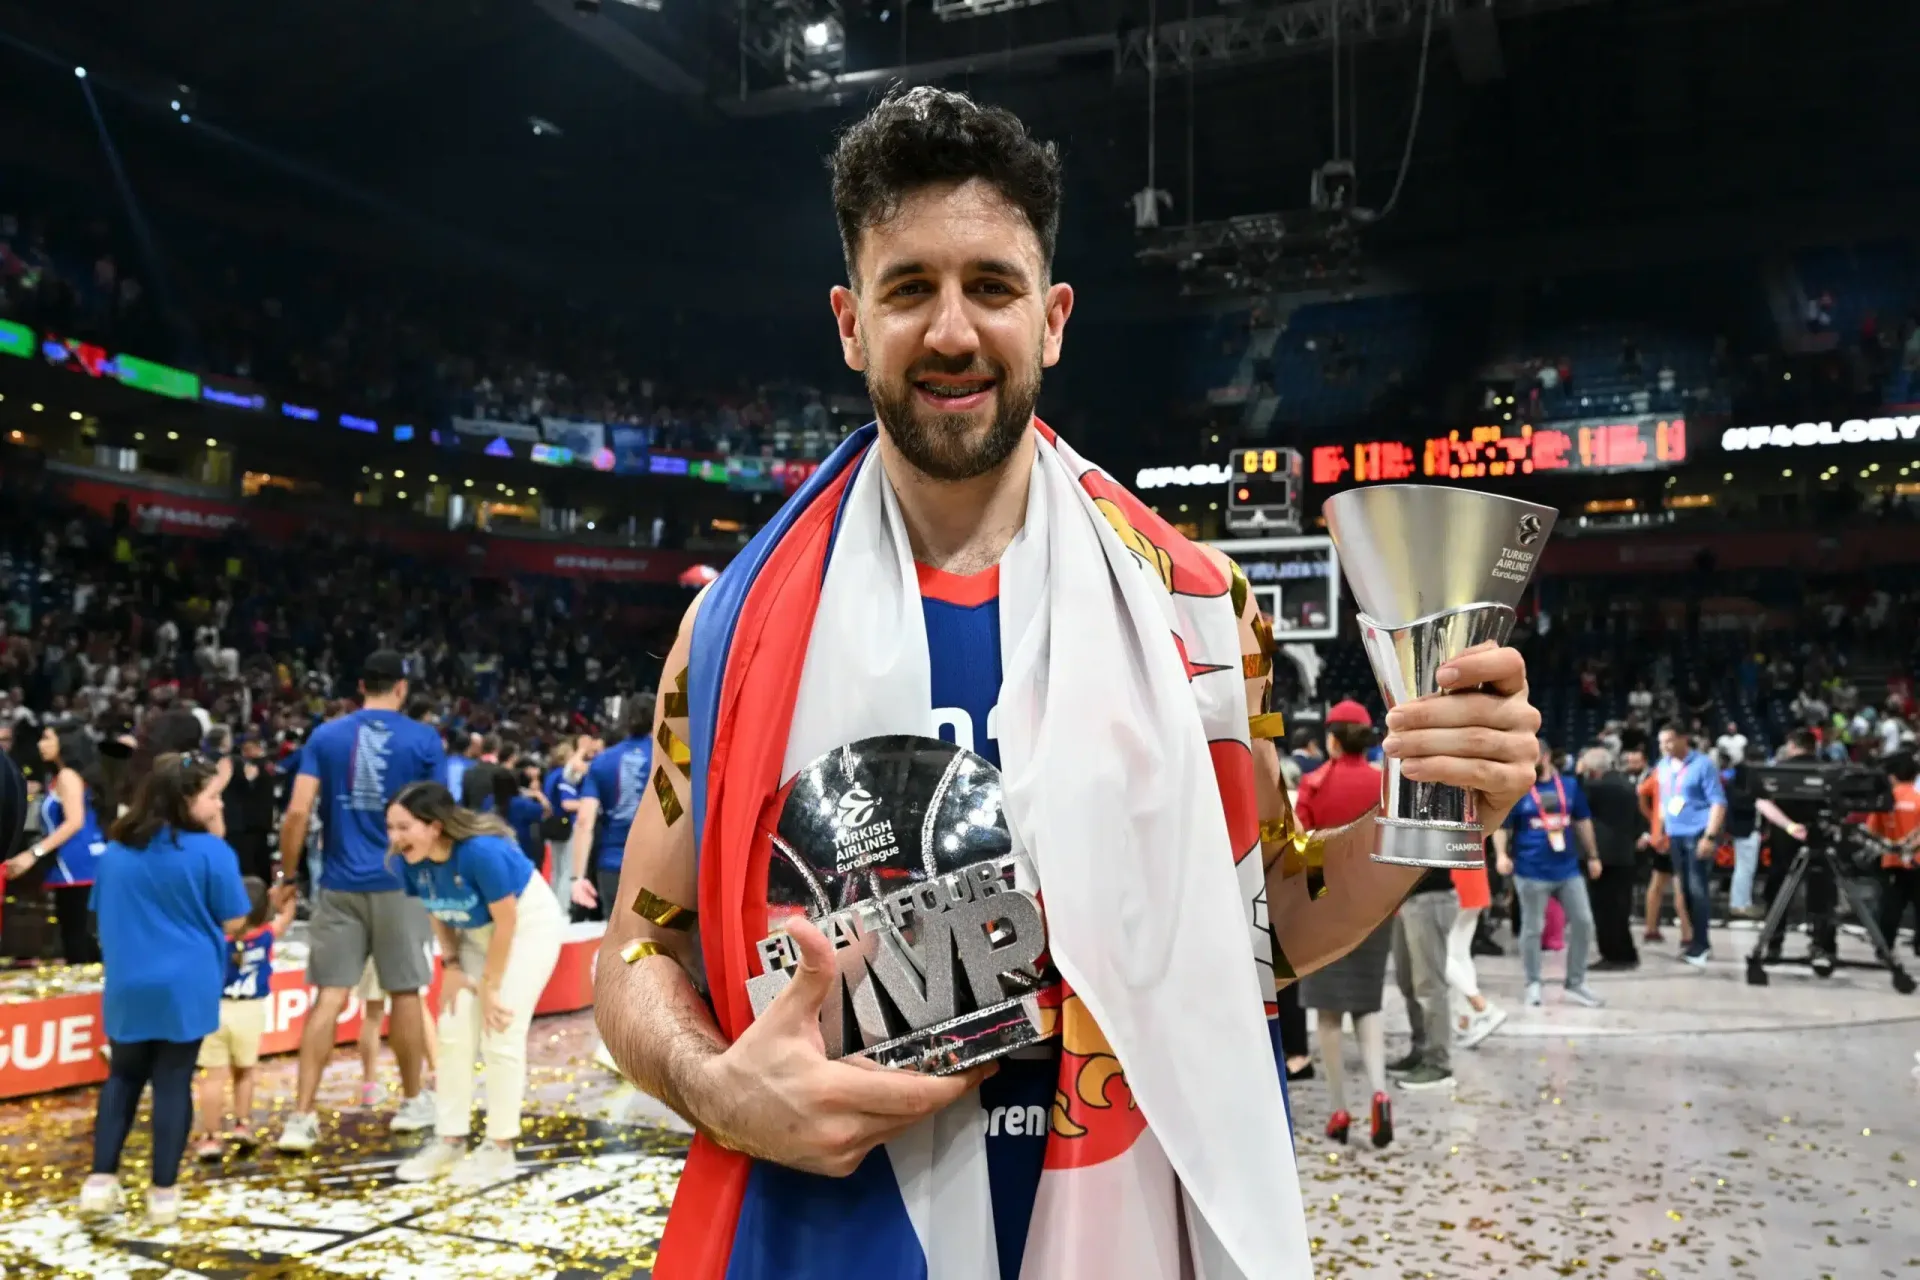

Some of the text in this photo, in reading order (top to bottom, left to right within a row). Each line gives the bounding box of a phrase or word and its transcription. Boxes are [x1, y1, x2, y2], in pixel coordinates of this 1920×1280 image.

[1496, 558, 1530, 573] AIRLINES
[1502, 547, 1534, 562] TURKISH
[832, 820, 892, 849] TURKISH
[836, 832, 896, 862] AIRLINES
[836, 846, 899, 874] EuroLeague
[756, 861, 1006, 975] FIAL FOUR
[0, 1014, 95, 1070] UE
[983, 1105, 1050, 1137] ren
